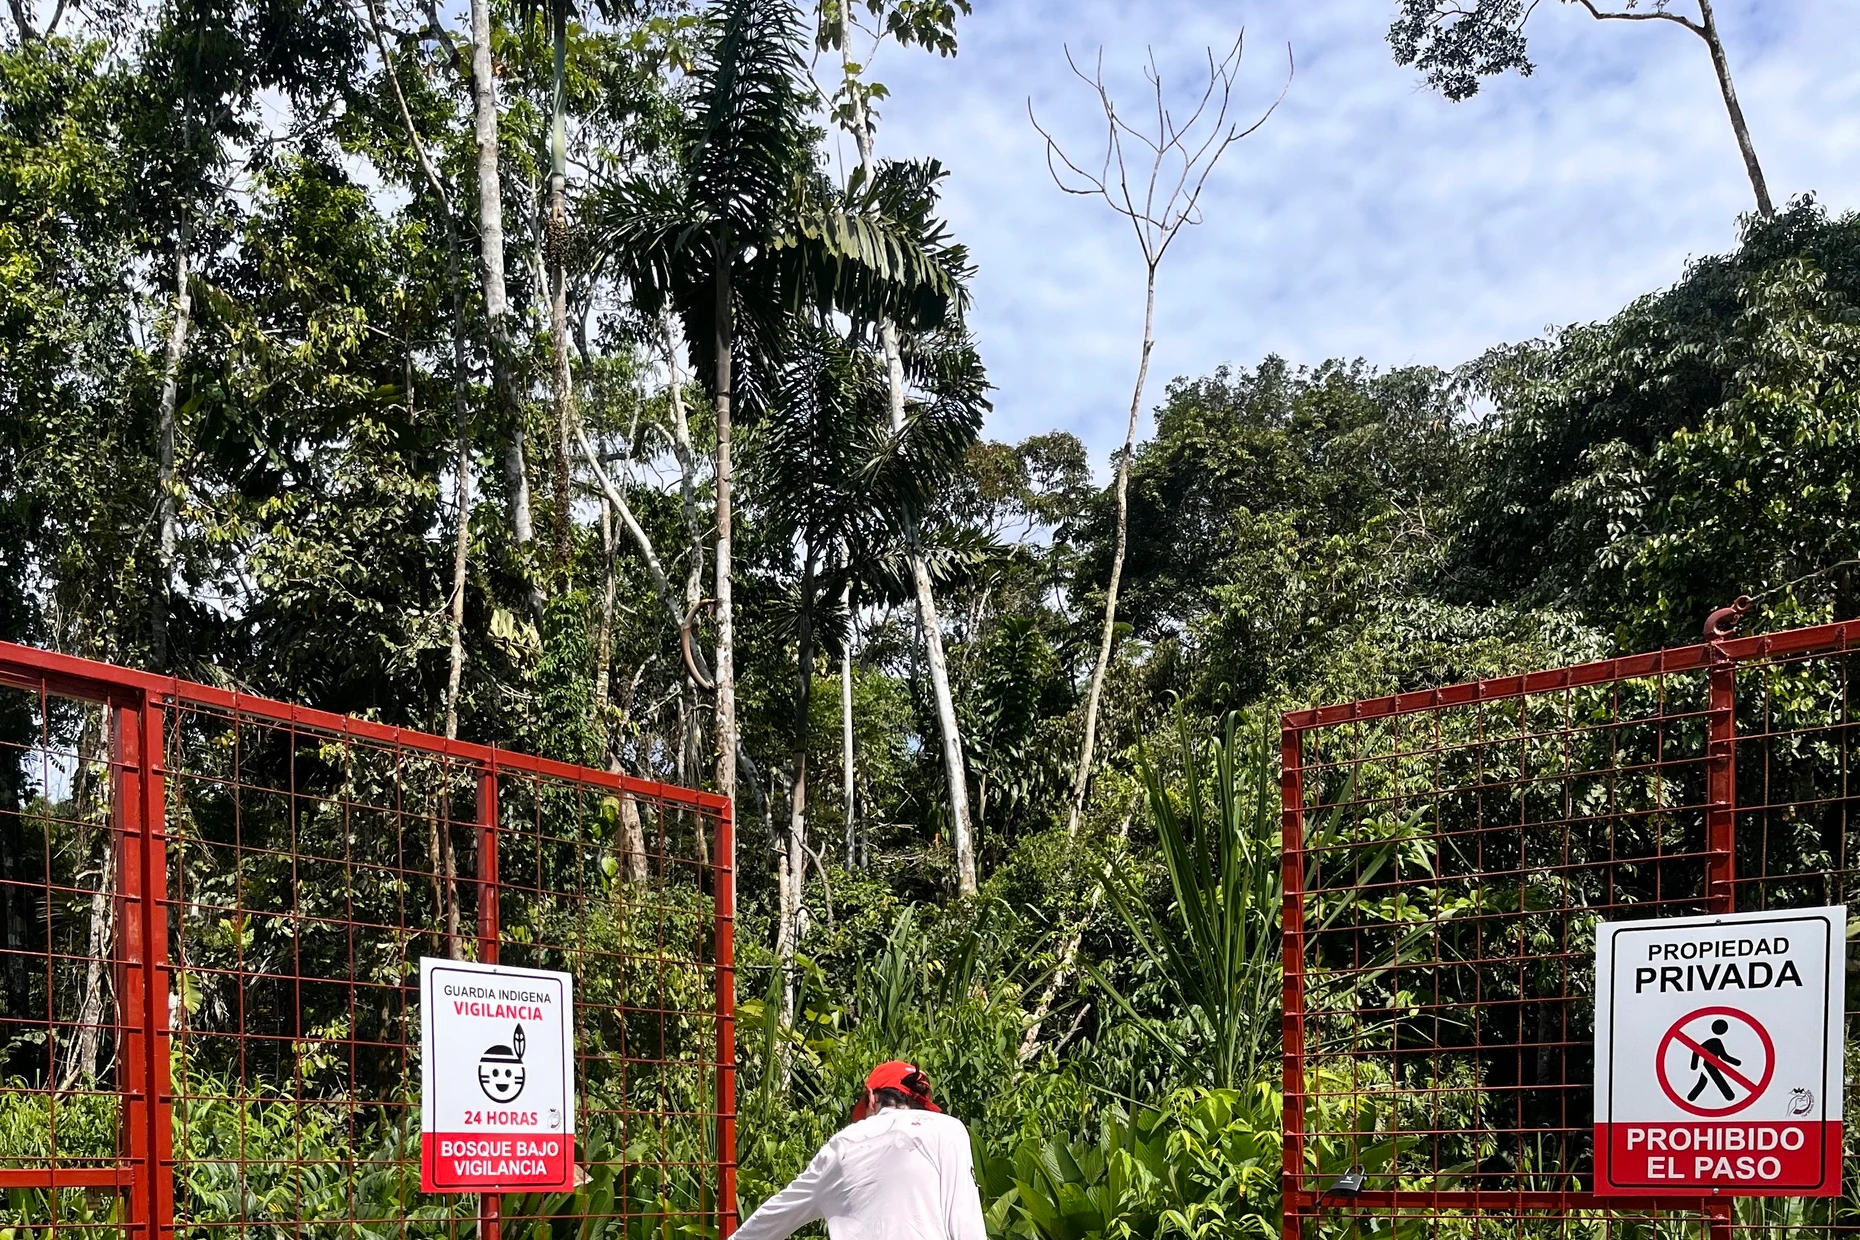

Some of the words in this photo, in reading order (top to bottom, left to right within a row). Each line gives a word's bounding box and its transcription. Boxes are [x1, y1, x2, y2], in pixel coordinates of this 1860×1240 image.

[1648, 937, 1790, 961] PROPIEDAD
[1635, 960, 1803, 993] PRIVADA
[444, 984, 496, 1000] GUARDIA
[498, 989, 552, 1004] INDIGENA
[453, 1001, 543, 1021] VIGILANCIA
[464, 1110, 482, 1125] 24
[487, 1111, 538, 1126] HORAS
[441, 1140, 511, 1157] BOSQUE
[516, 1141, 559, 1157] BAJO
[1627, 1127, 1805, 1151] PROHIBIDO
[454, 1160, 547, 1176] VIGILANCIA
[1647, 1156, 1685, 1179] EL
[1694, 1156, 1781, 1180] PASO
